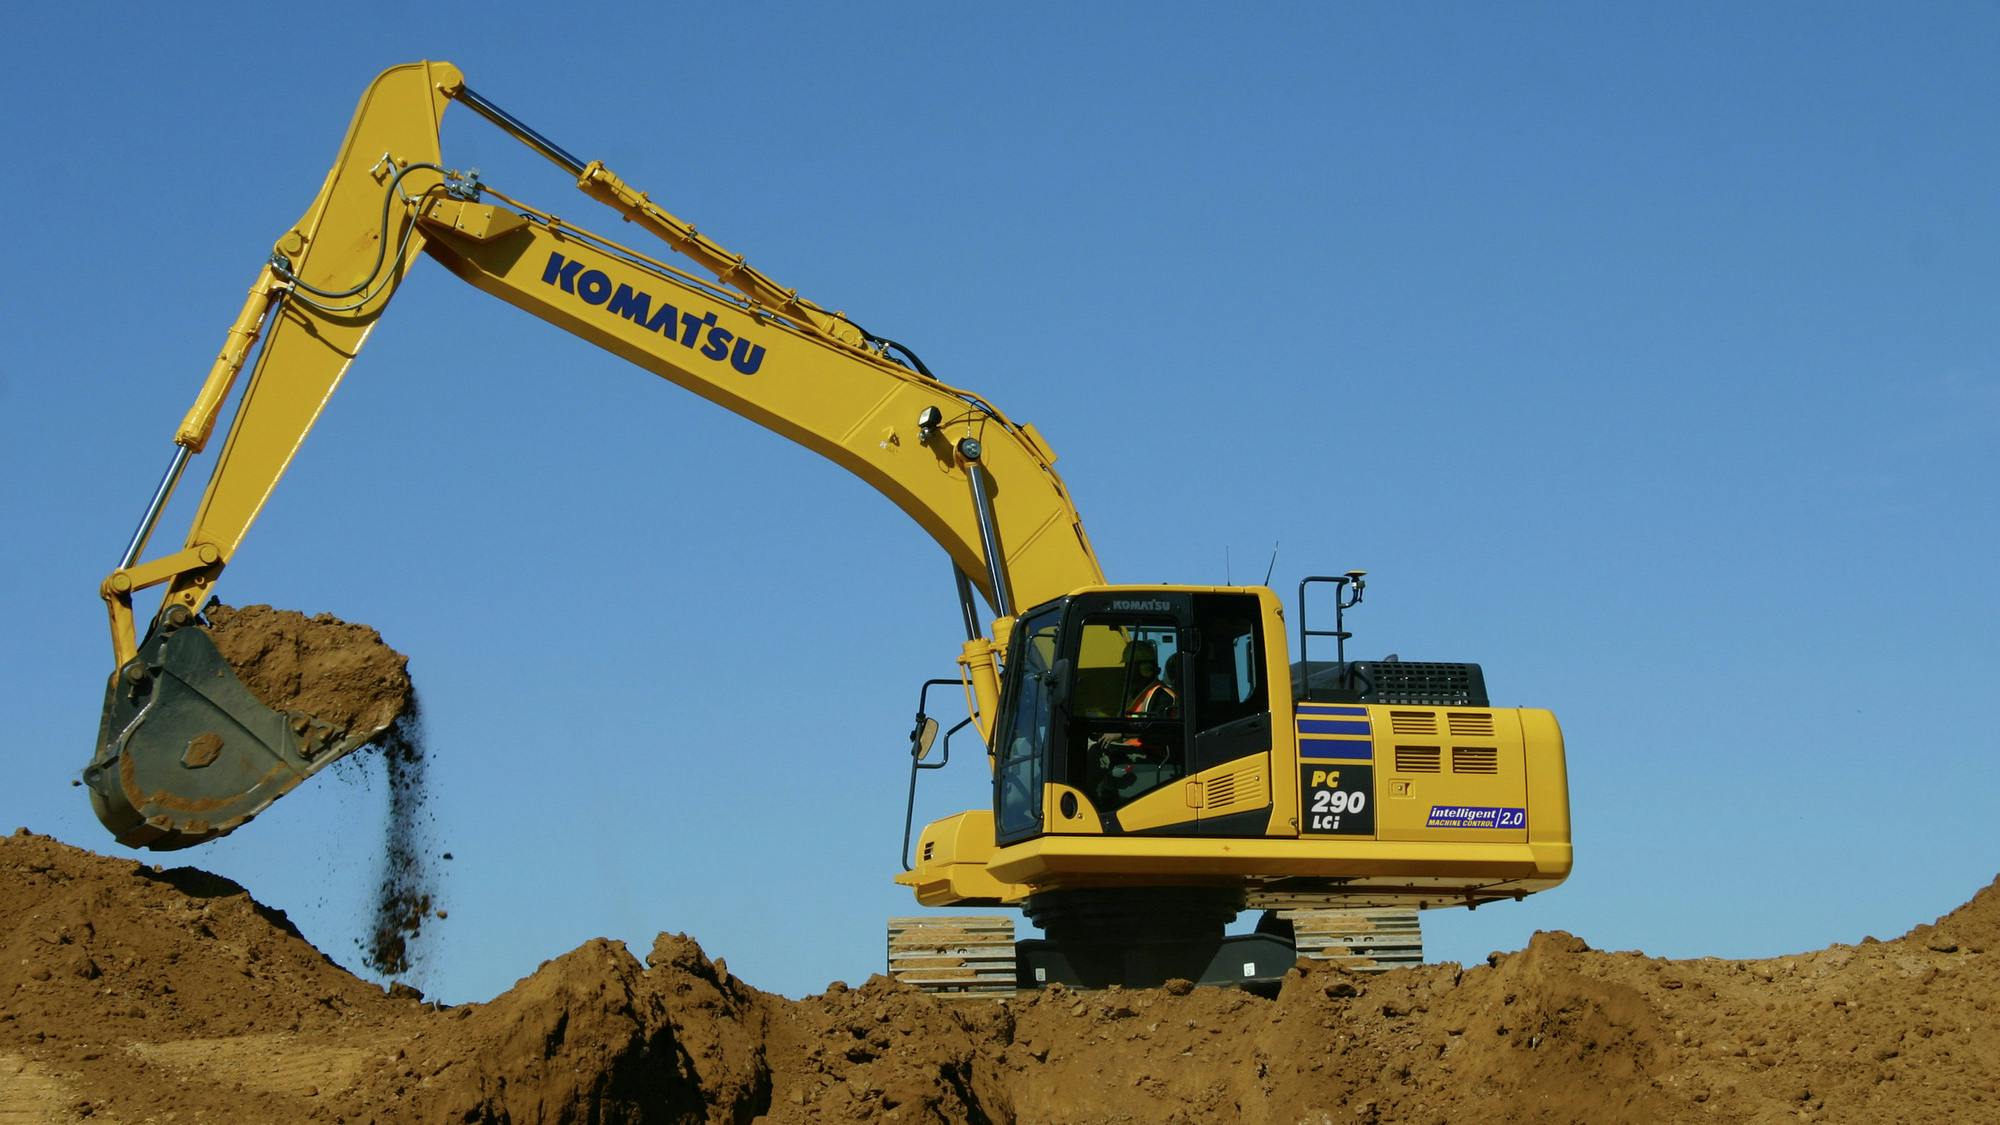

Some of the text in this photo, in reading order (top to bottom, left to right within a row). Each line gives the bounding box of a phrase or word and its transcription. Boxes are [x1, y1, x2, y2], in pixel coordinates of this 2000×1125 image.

[541, 251, 767, 375] KOMATSU
[1113, 599, 1170, 611] KOMATSU
[1311, 770, 1340, 788] PC
[1311, 790, 1366, 814] 290
[1431, 807, 1497, 820] intelligent
[1500, 812, 1523, 825] 2.0
[1312, 815, 1340, 830] LCi
[1427, 819, 1461, 827] MACHINE
